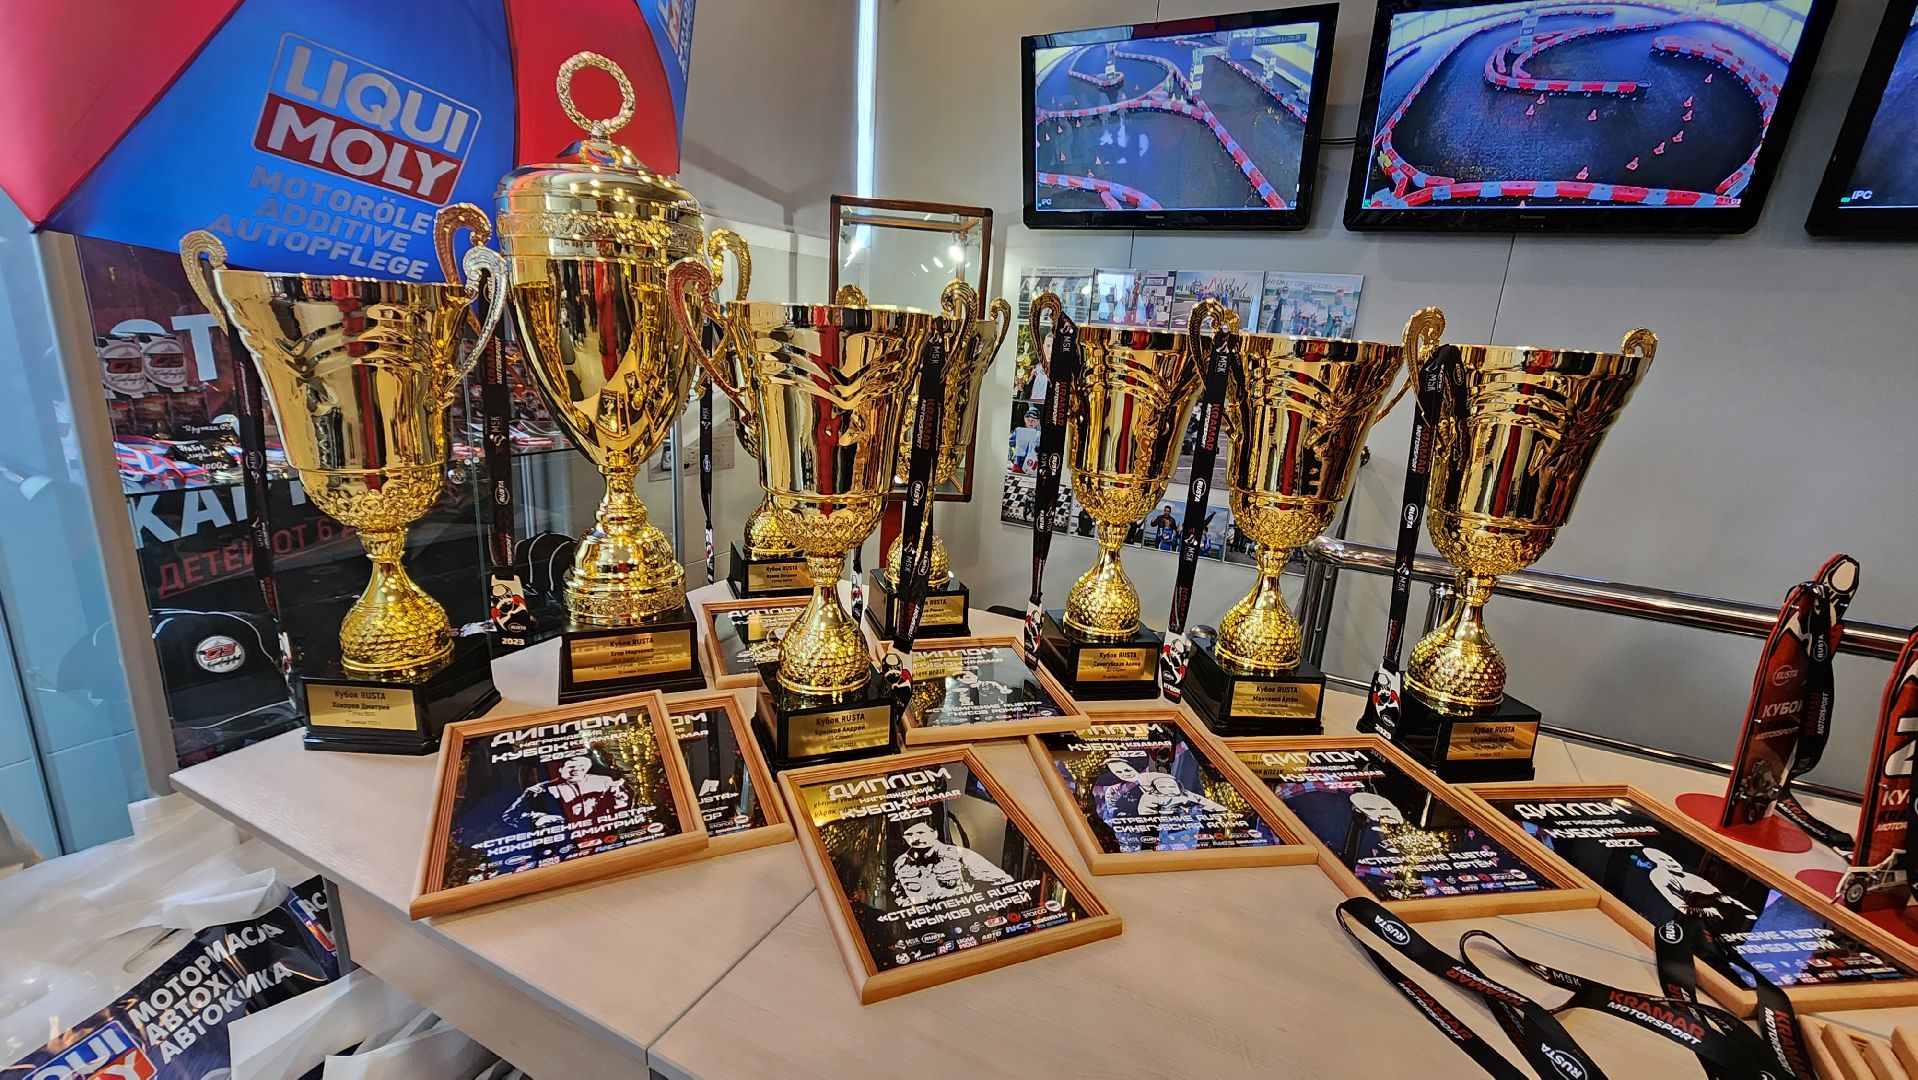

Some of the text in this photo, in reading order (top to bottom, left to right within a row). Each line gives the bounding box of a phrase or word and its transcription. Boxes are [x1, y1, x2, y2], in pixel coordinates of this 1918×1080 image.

[284, 45, 470, 154] LIQUI
[267, 102, 461, 197] MOLY
[250, 165, 434, 235] MOTORÖLE
[1851, 189, 1873, 200] IPC
[255, 198, 412, 254] ADDITIVE
[204, 215, 429, 281] AUTOPFLEGE
[1062, 332, 1071, 352] MSK
[494, 336, 502, 385] MOTORSPORT
[931, 346, 941, 366] MSK
[1217, 354, 1227, 374] MSK
[1427, 373, 1437, 392] MSK
[1052, 382, 1060, 426] MOTORSPORT
[490, 415, 501, 433] MSK
[917, 398, 927, 449] MOTORSPORT
[1202, 403, 1213, 449] MOTORSPORT
[1207, 403, 1221, 450] KRAMAR
[1411, 425, 1423, 473] MOTORSPORT
[1417, 425, 1431, 475] KRAMAR
[1050, 454, 1058, 476] RUSTA
[497, 480, 506, 503] RUSTA
[912, 481, 921, 507] RUSTA
[1195, 479, 1205, 502] RUSTA
[1406, 503, 1415, 529] RUSTA
[274, 524, 308, 554] ОТ
[904, 555, 913, 574] MSK
[1184, 547, 1195, 564] MSK
[1398, 573, 1406, 593] MSK
[501, 636, 526, 647] 2023
[632, 637, 655, 646] RUSTA
[1817, 633, 1825, 659] RUSTA
[1100, 652, 1118, 660] Кубок
[1775, 669, 1798, 680] RUSTA
[335, 690, 386, 700] Кубок RUSTA
[816, 712, 865, 726] Кубок RUSTA
[1817, 692, 1829, 735] MOTORSPORT
[491, 712, 628, 748] ДИПЛОМ
[842, 723, 866, 733] Андрей
[1473, 726, 1494, 735] Кубок
[491, 742, 569, 764] КУБОК
[539, 749, 589, 763] 2023
[1067, 740, 1173, 752] КУБОК KRAMAR
[1109, 750, 1148, 758] 2023
[1260, 750, 1369, 766] ДИПЛОМ
[829, 767, 952, 801] ДИПЛОМ
[1279, 773, 1342, 782] КУБОК
[1324, 781, 1365, 789] 2023
[839, 789, 961, 820] КУБОК KRAMAR
[888, 807, 933, 822] 2023
[1514, 802, 1632, 820] ДИПЛОМ
[471, 804, 658, 850] «СТРЕМЛЕНИЕ RUSTA»
[570, 815, 647, 840] ДМИТРИЙ
[1104, 813, 1244, 825] «СТРЕМЛЕНИЕ RUSTA»
[1112, 820, 1250, 834] СИНЕГУБСКАЯ АЛИНА
[1544, 825, 1660, 839] КУБОК KRAMAR
[1598, 838, 1645, 848] 2023
[1357, 851, 1498, 866] «СТРЕМЛЕНИЕ RUSTA»
[1453, 858, 1498, 870] АРТЁМ
[877, 879, 1041, 923] «СТРЕМЛЕНИЕ RUSTA»
[905, 892, 1032, 930] КРЫМОВ АНДРЕЙ
[923, 932, 946, 943] RUSTA
[1005, 921, 1032, 934] NCS
[1373, 914, 1406, 943] RUSTA
[1784, 928, 1835, 940] RUSTA»
[905, 937, 920, 947] MSK
[1446, 968, 1525, 1006] KRAMAR
[1452, 965, 1529, 1003] MOTORSPORT
[1552, 970, 1583, 988] MSK
[1398, 981, 1465, 1041] MOTORSPORT
[1403, 979, 1474, 1040] KRAMAR
[1609, 990, 1706, 1039] KRAMAR
[1607, 1001, 1702, 1046] MOTORSPORT
[1541, 1042, 1583, 1079] RUSTA
